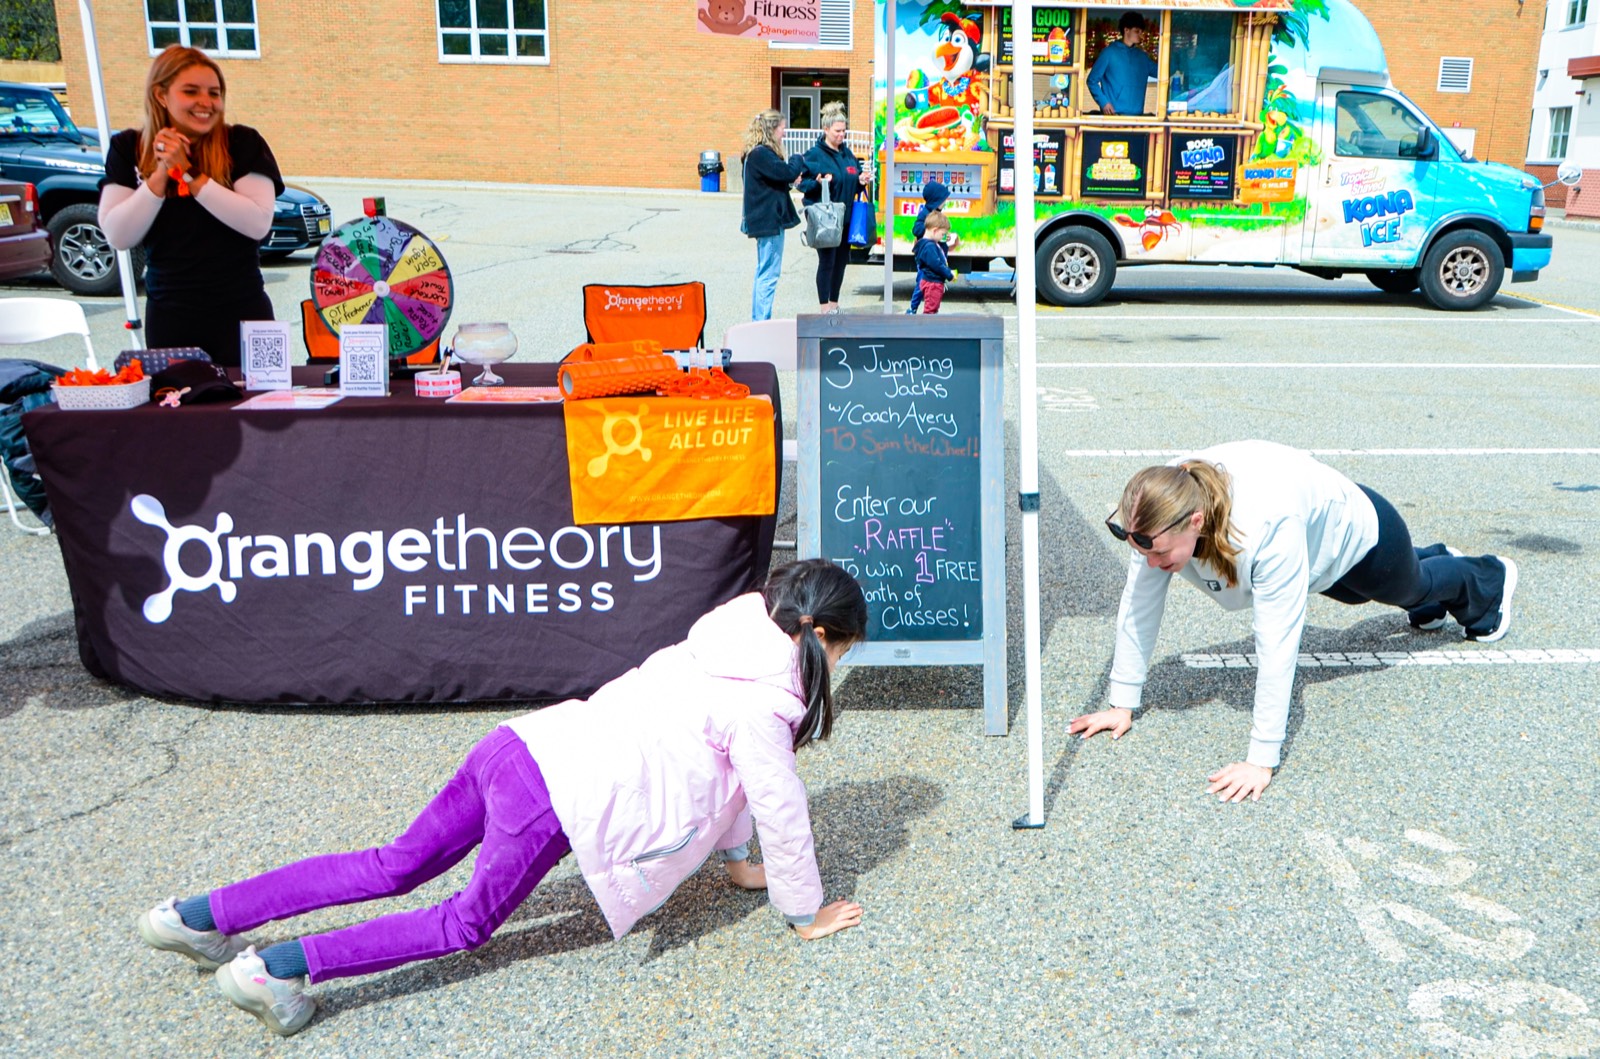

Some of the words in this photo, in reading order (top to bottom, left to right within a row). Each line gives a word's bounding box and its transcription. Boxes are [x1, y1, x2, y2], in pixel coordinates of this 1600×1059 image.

[753, 0, 817, 20] Fitness
[1036, 9, 1071, 27] GOOD
[1106, 144, 1124, 157] 62
[1181, 145, 1225, 167] KONA
[1186, 138, 1214, 150] BOOK
[1244, 168, 1275, 180] KONA
[1275, 167, 1294, 179] ICE
[1340, 166, 1379, 186] Tropical
[1342, 189, 1414, 224] KONA
[1360, 216, 1401, 247] ICE
[405, 245, 427, 266] Again
[414, 256, 437, 273] Spin
[318, 285, 345, 297] Towel
[825, 347, 854, 389] 3
[858, 344, 954, 383] Jumping
[880, 373, 948, 398] Jacks
[664, 410, 707, 428] LIVE
[713, 406, 755, 424] LIFE
[897, 401, 958, 437] Avery
[669, 431, 706, 450] ALL
[711, 427, 753, 446] OUT
[861, 429, 901, 460] Spin
[834, 484, 896, 523] Enter
[899, 496, 937, 516] our
[864, 518, 947, 552] RAFFLE
[832, 558, 860, 580] To
[915, 551, 935, 583] 1
[936, 559, 980, 582] FREE
[405, 581, 615, 615] FITNESS
[860, 581, 899, 603] onth
[904, 584, 922, 608] of
[881, 603, 970, 630] Classes!
